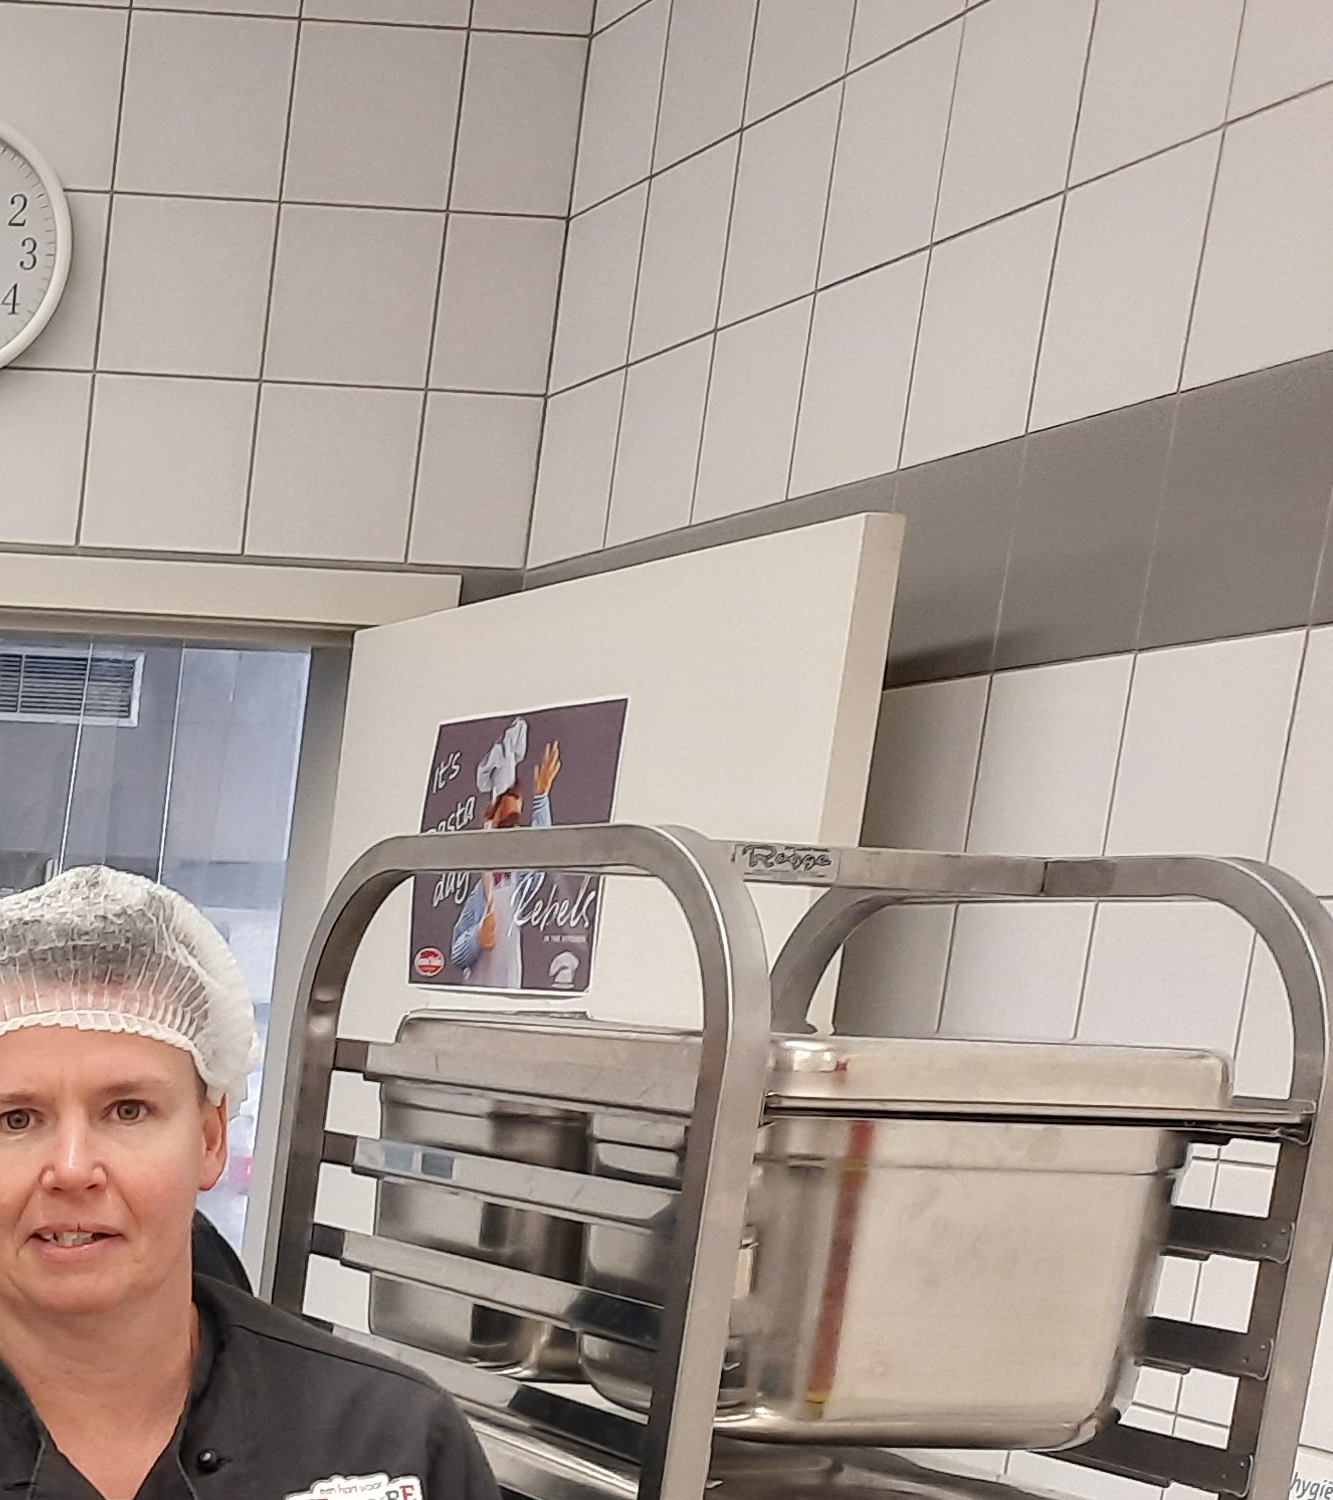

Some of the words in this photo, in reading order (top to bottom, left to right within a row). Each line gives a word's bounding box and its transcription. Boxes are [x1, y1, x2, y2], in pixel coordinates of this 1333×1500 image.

[8, 194, 27, 227] 2
[19, 237, 37, 270] 3
[1, 283, 20, 315] 4
[426, 796, 476, 832] asta
[433, 871, 469, 908] day
[508, 872, 596, 937] Rebels
